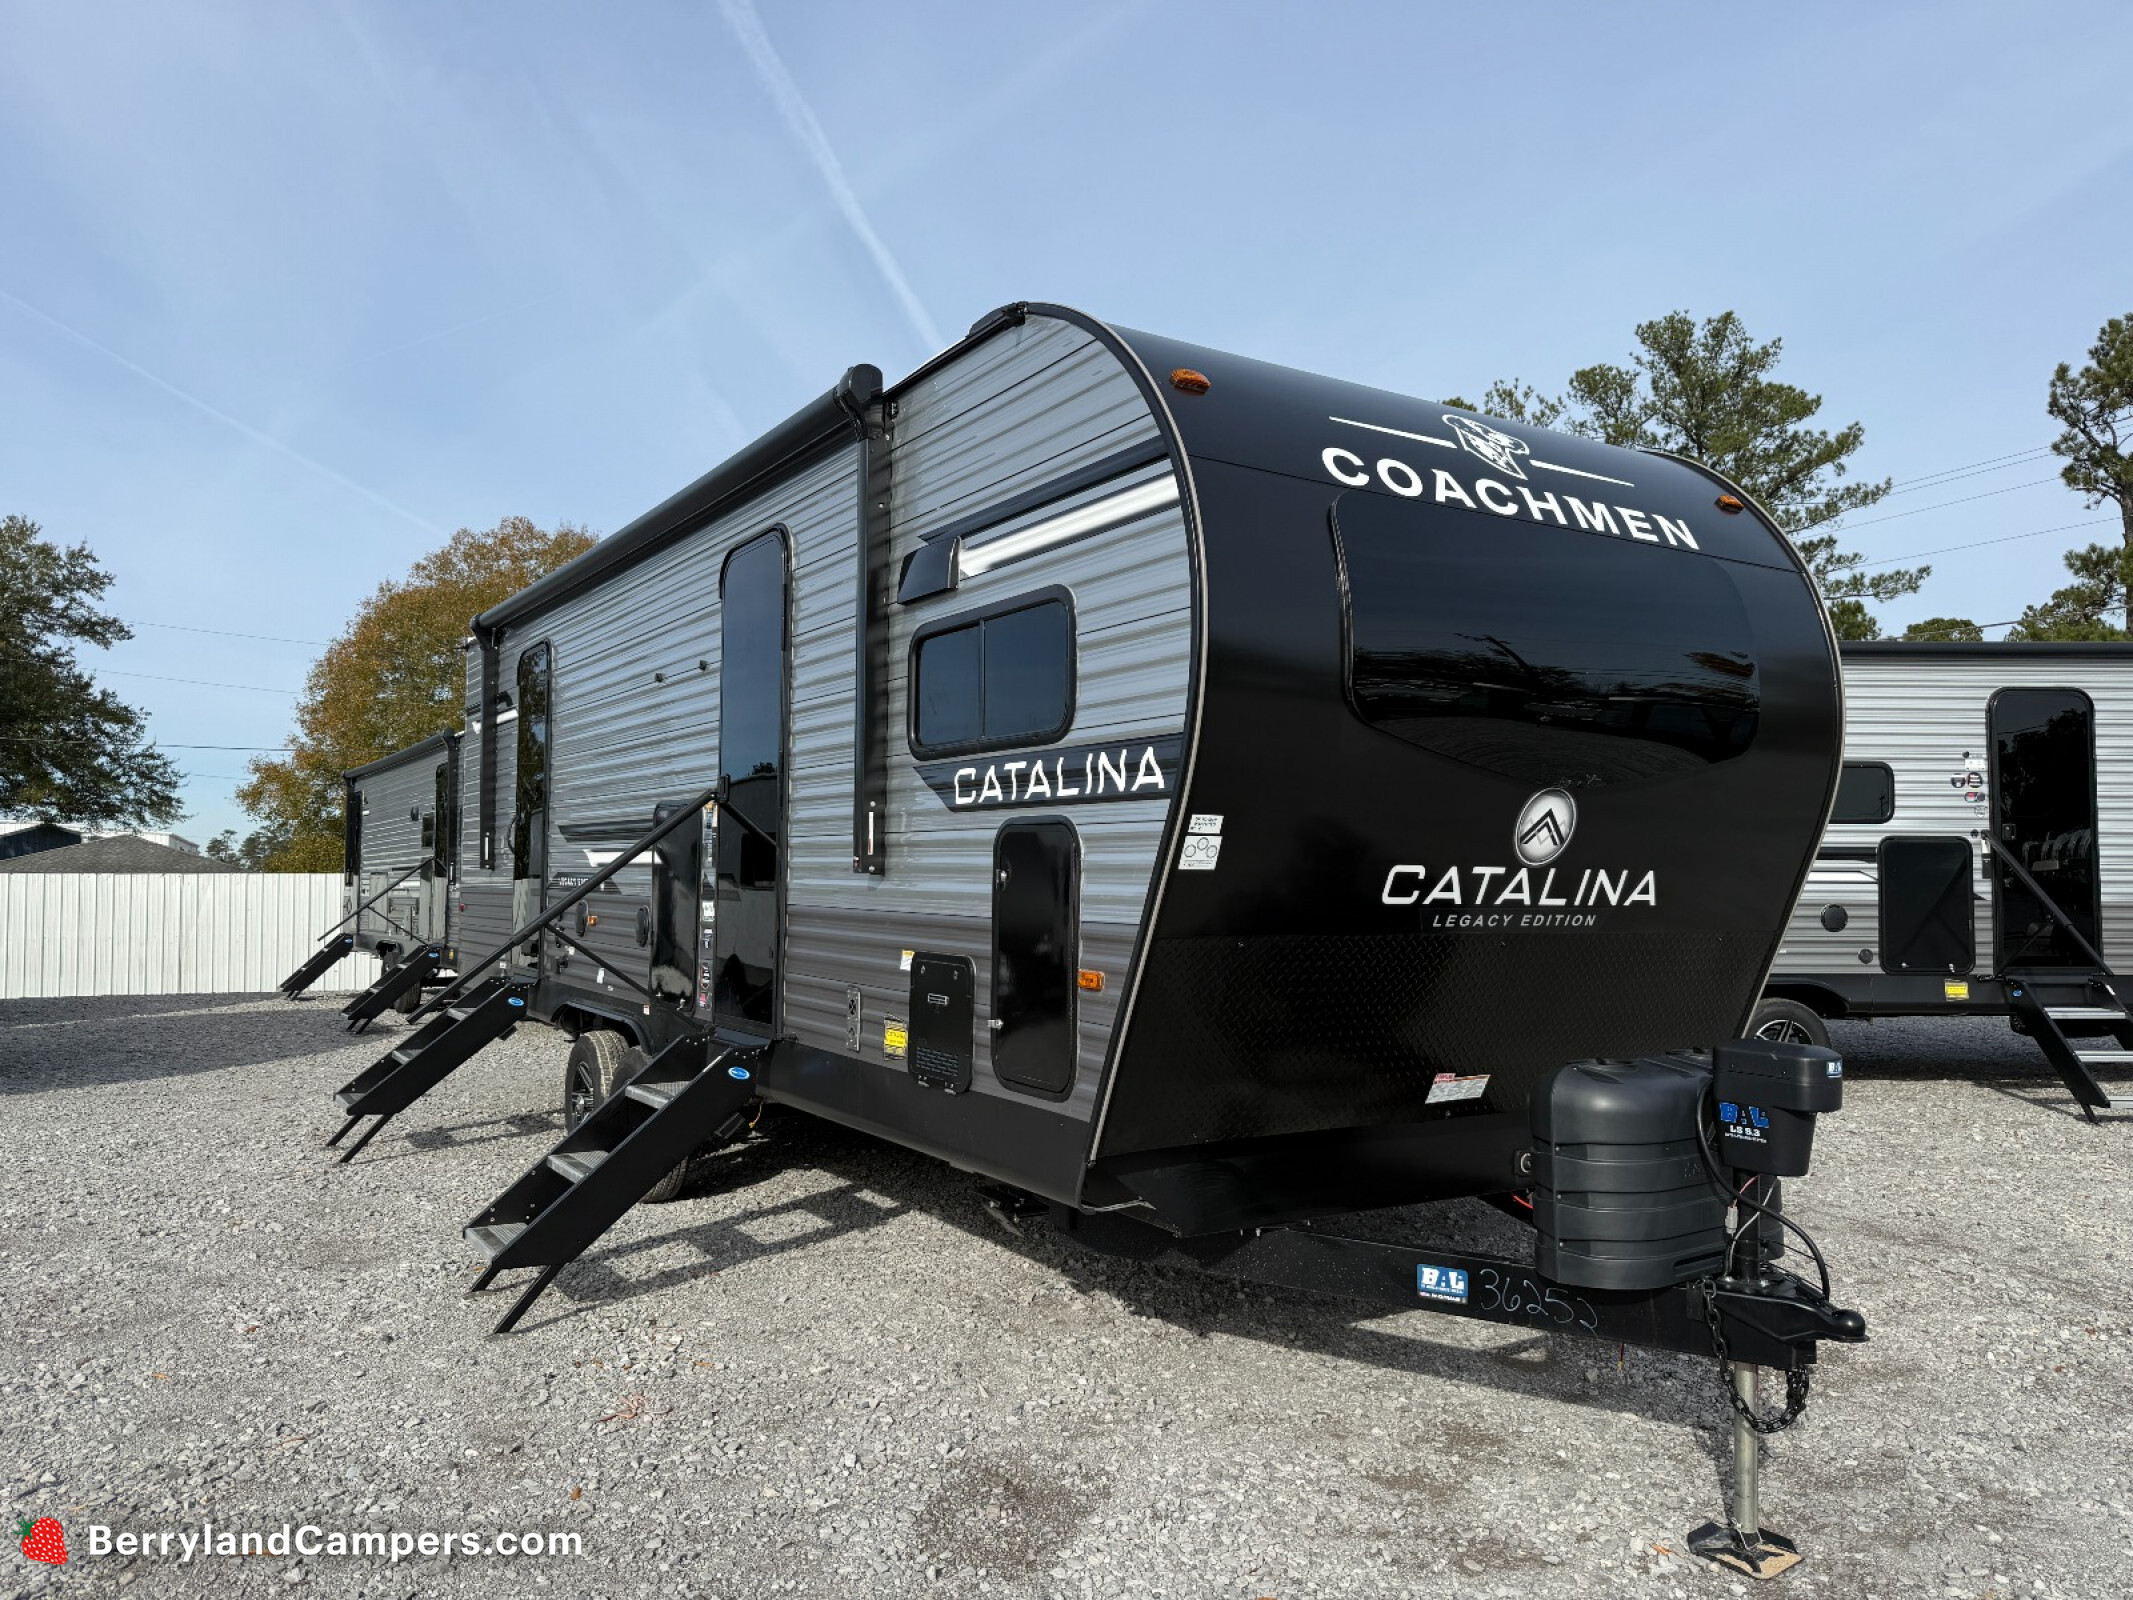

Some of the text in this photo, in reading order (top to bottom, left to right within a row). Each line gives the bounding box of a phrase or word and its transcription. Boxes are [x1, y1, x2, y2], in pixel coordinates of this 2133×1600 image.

[1321, 446, 1700, 550] COACHMEN
[954, 746, 1166, 805] CATALINA
[1381, 864, 1657, 906] CATALINA
[1432, 913, 1597, 928] LEGACY EDITION
